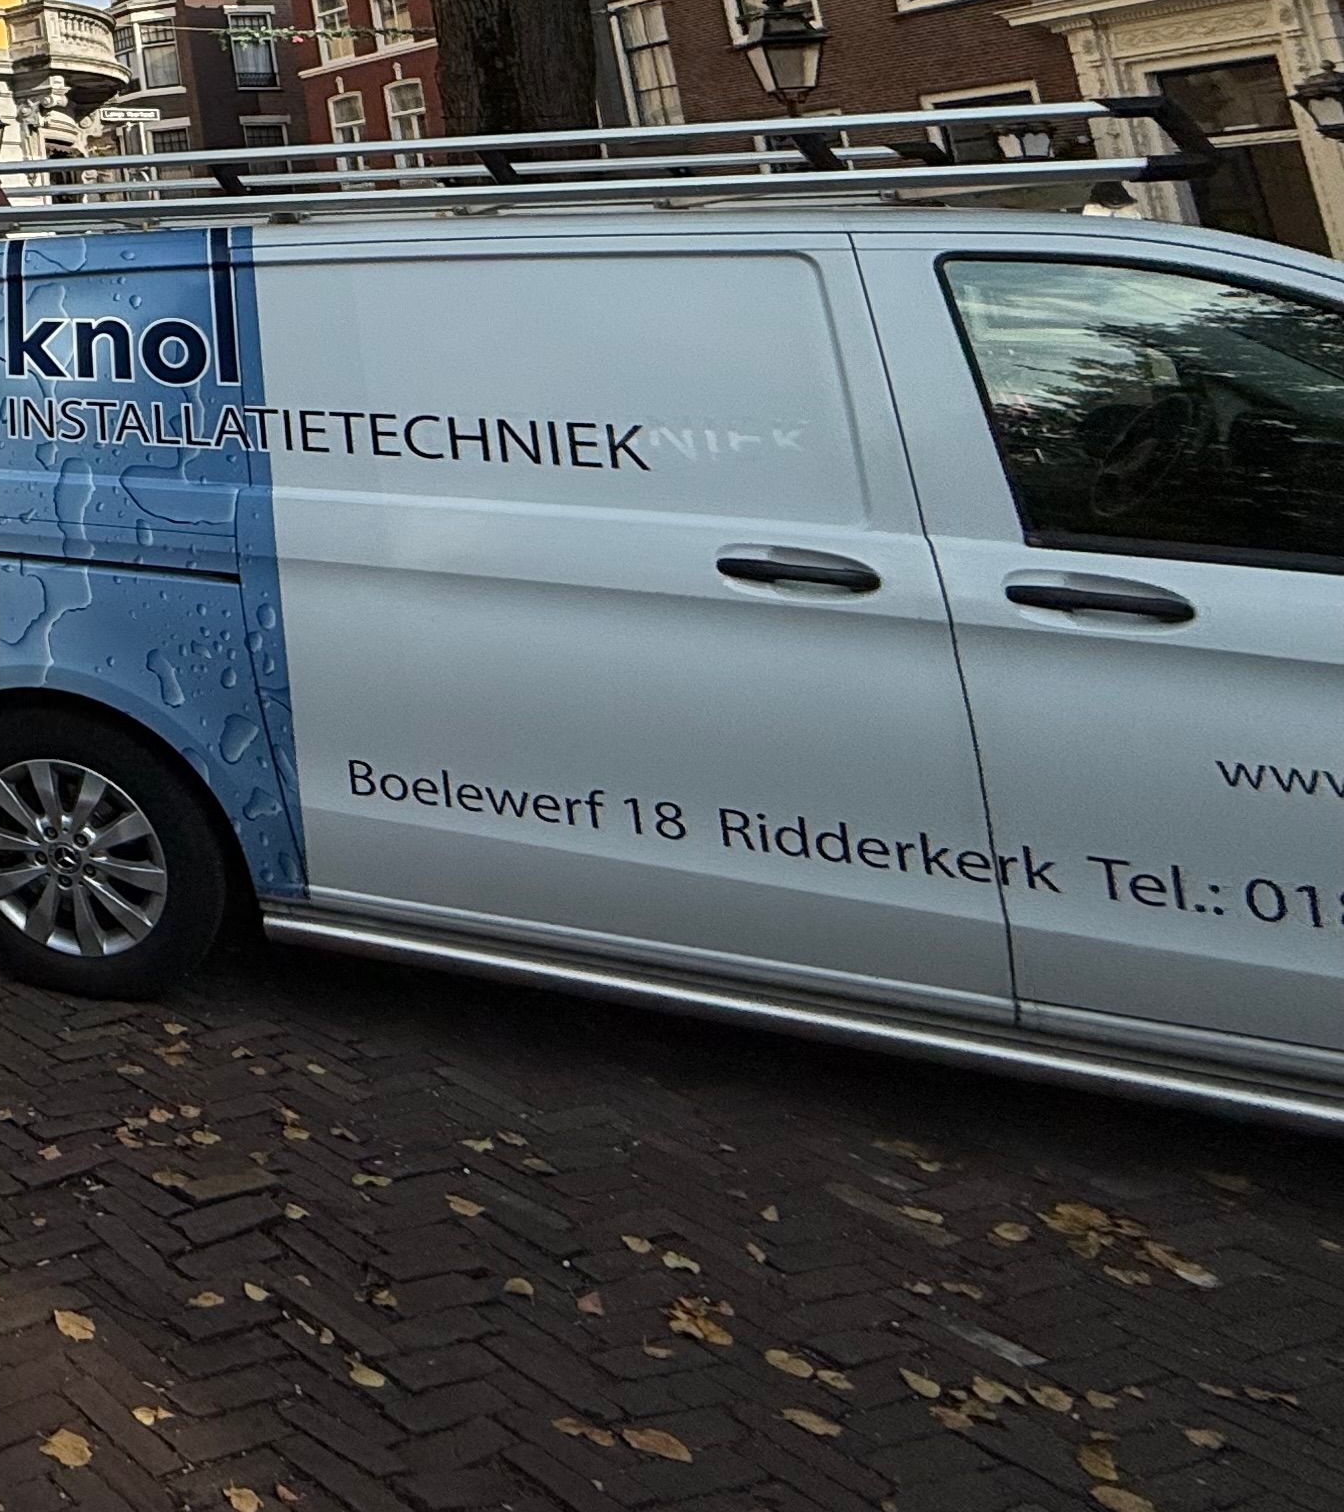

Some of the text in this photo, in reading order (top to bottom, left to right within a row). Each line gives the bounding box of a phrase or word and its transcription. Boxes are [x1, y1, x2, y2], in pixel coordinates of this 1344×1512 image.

[5, 225, 242, 386] knol
[5, 396, 651, 473] INSTALLATIETECHNIEK
[348, 759, 1344, 929] Boelewerf 18 Ridderkerk Tel.: 01
